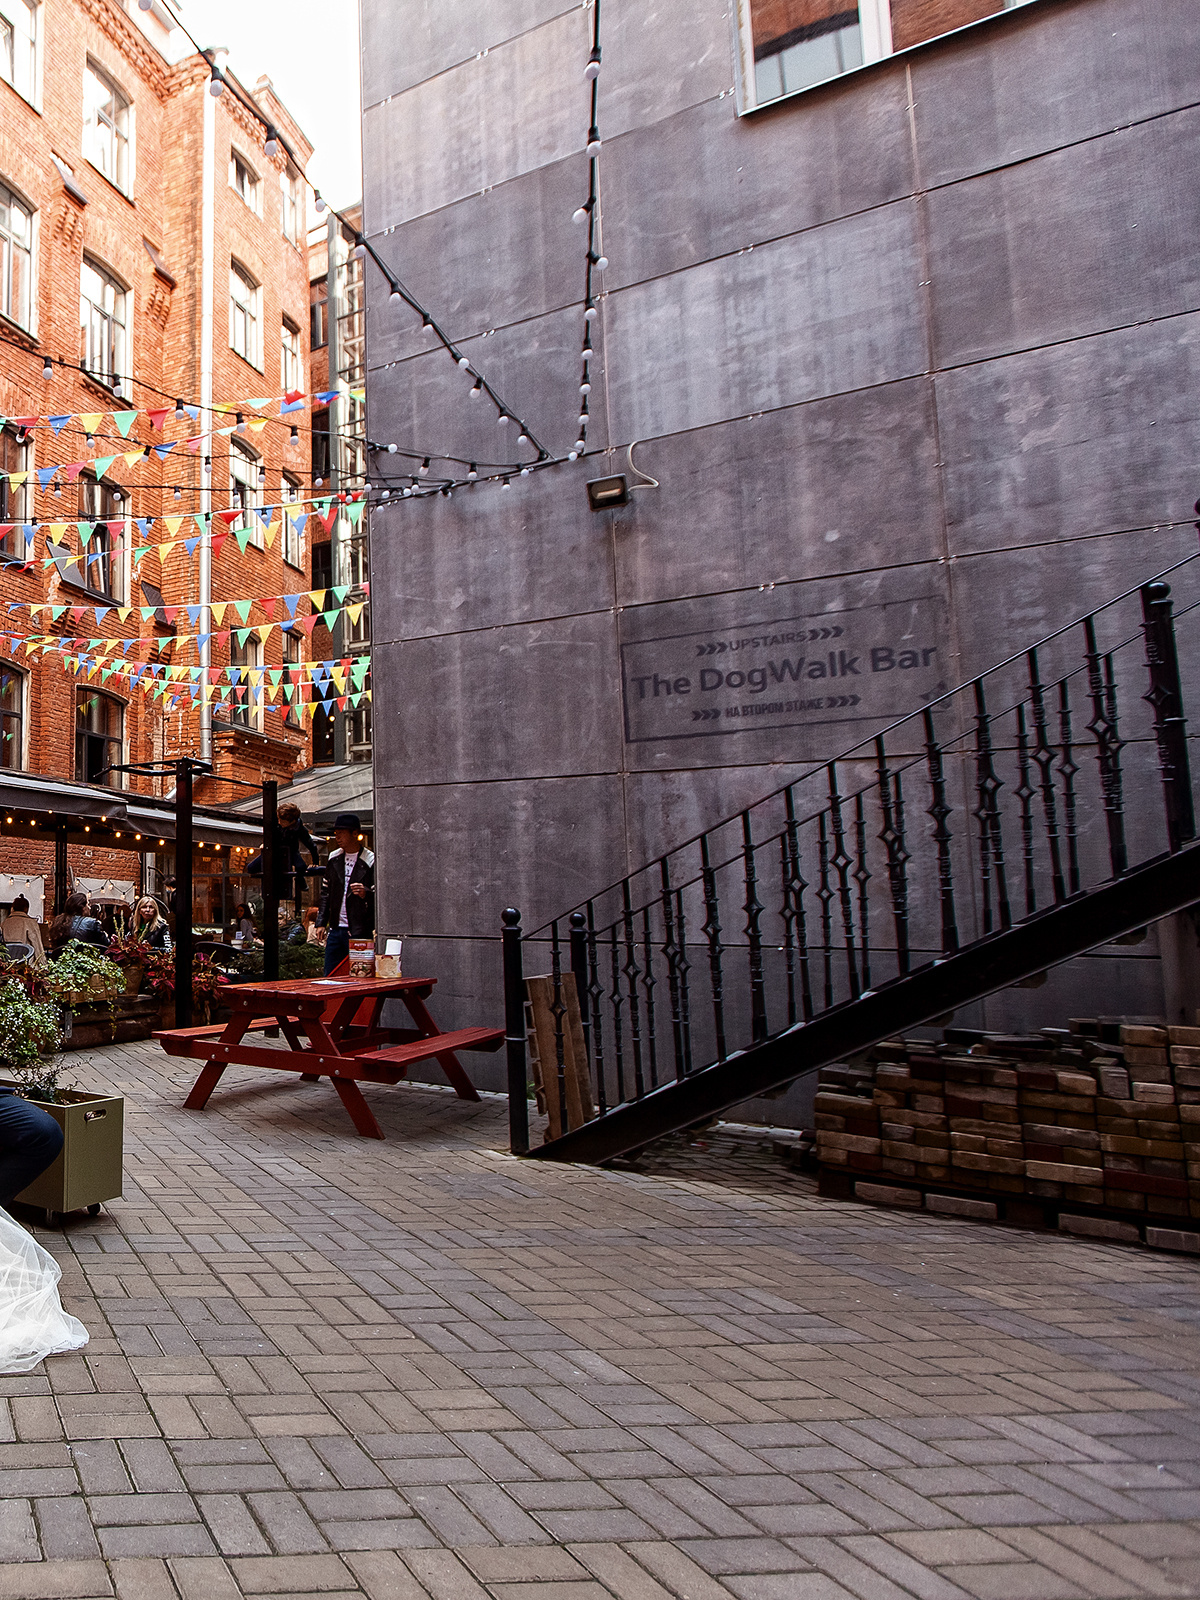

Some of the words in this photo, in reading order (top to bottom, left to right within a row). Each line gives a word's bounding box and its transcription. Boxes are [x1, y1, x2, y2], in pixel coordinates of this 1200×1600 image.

[729, 631, 806, 651] UPSTAIRS
[631, 673, 690, 700] The
[701, 650, 862, 694] DogWalk
[871, 646, 938, 673] Bar
[725, 706, 741, 718] НА
[742, 702, 784, 717] ВТОРОМ
[785, 697, 823, 712] ЭТАЖЕ
